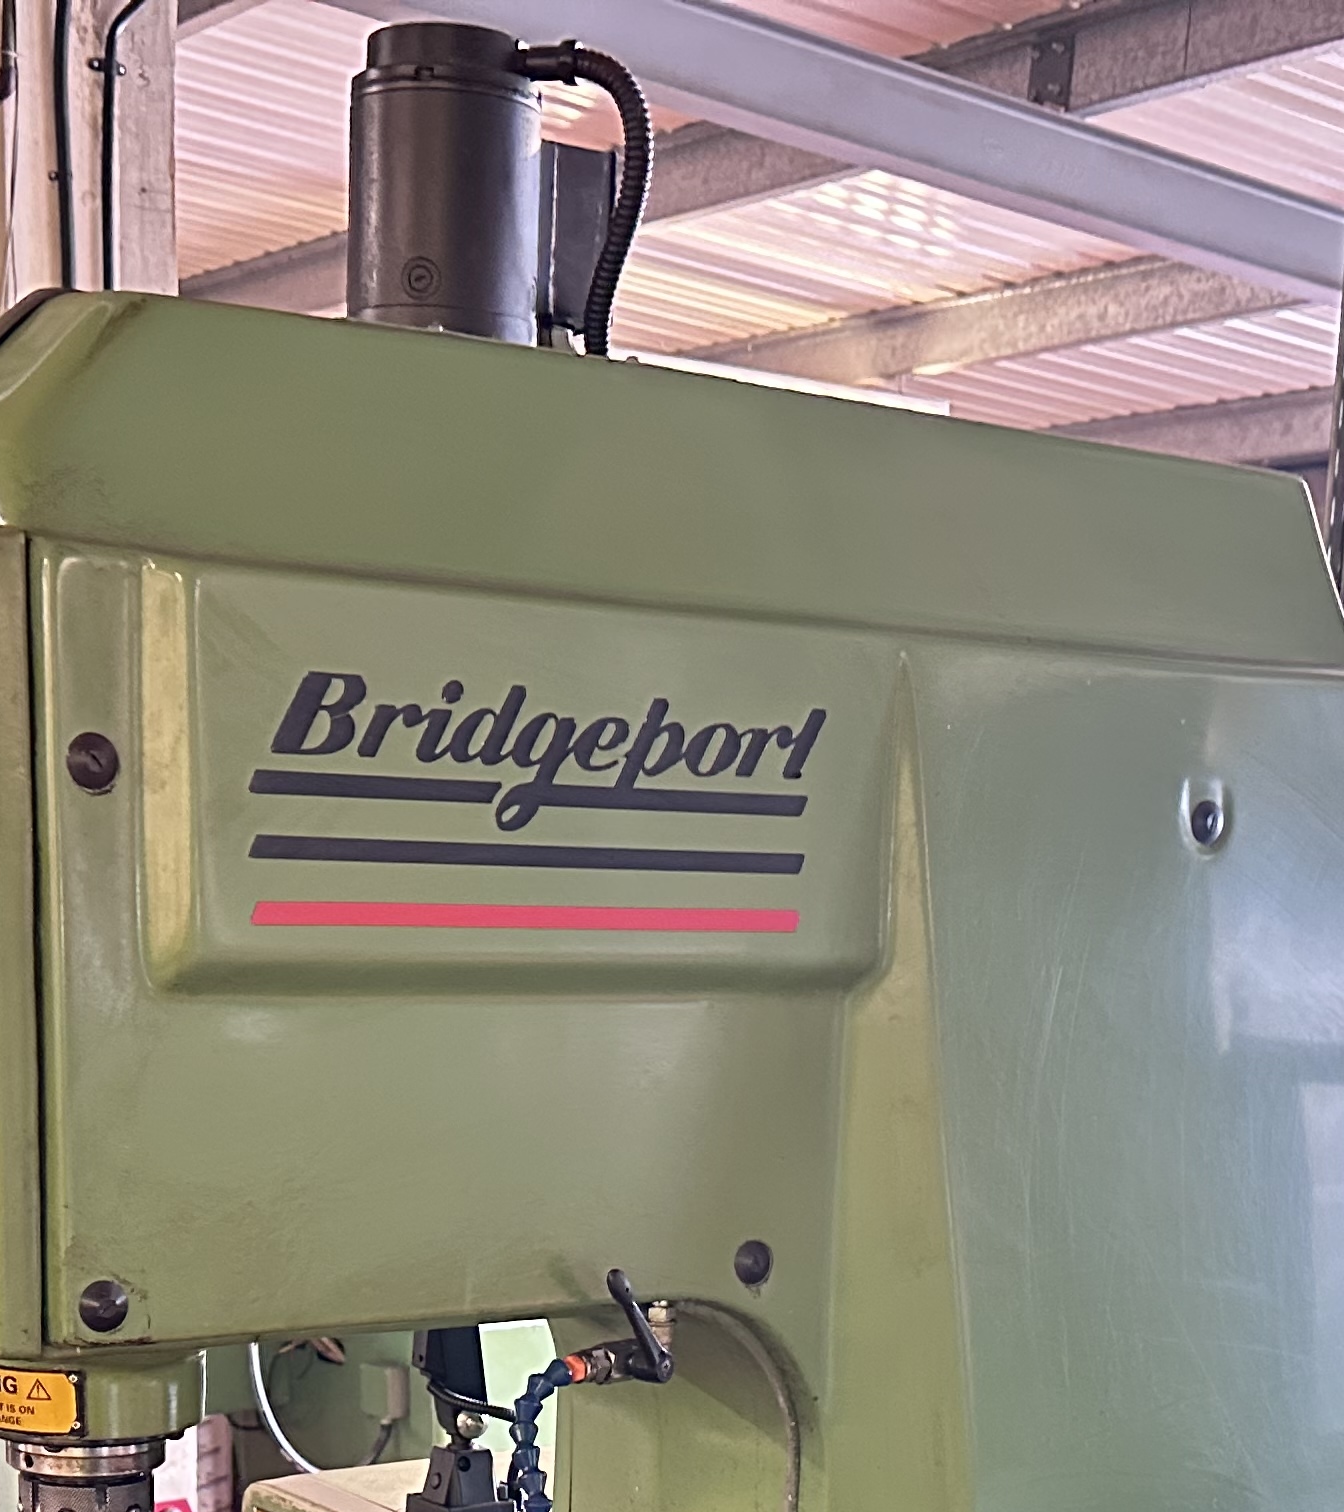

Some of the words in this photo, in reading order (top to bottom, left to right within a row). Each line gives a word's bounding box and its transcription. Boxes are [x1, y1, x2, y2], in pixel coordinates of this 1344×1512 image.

[270, 671, 827, 831] Bridgeport
[6, 1403, 16, 1413] IS
[19, 1405, 35, 1415] ON
